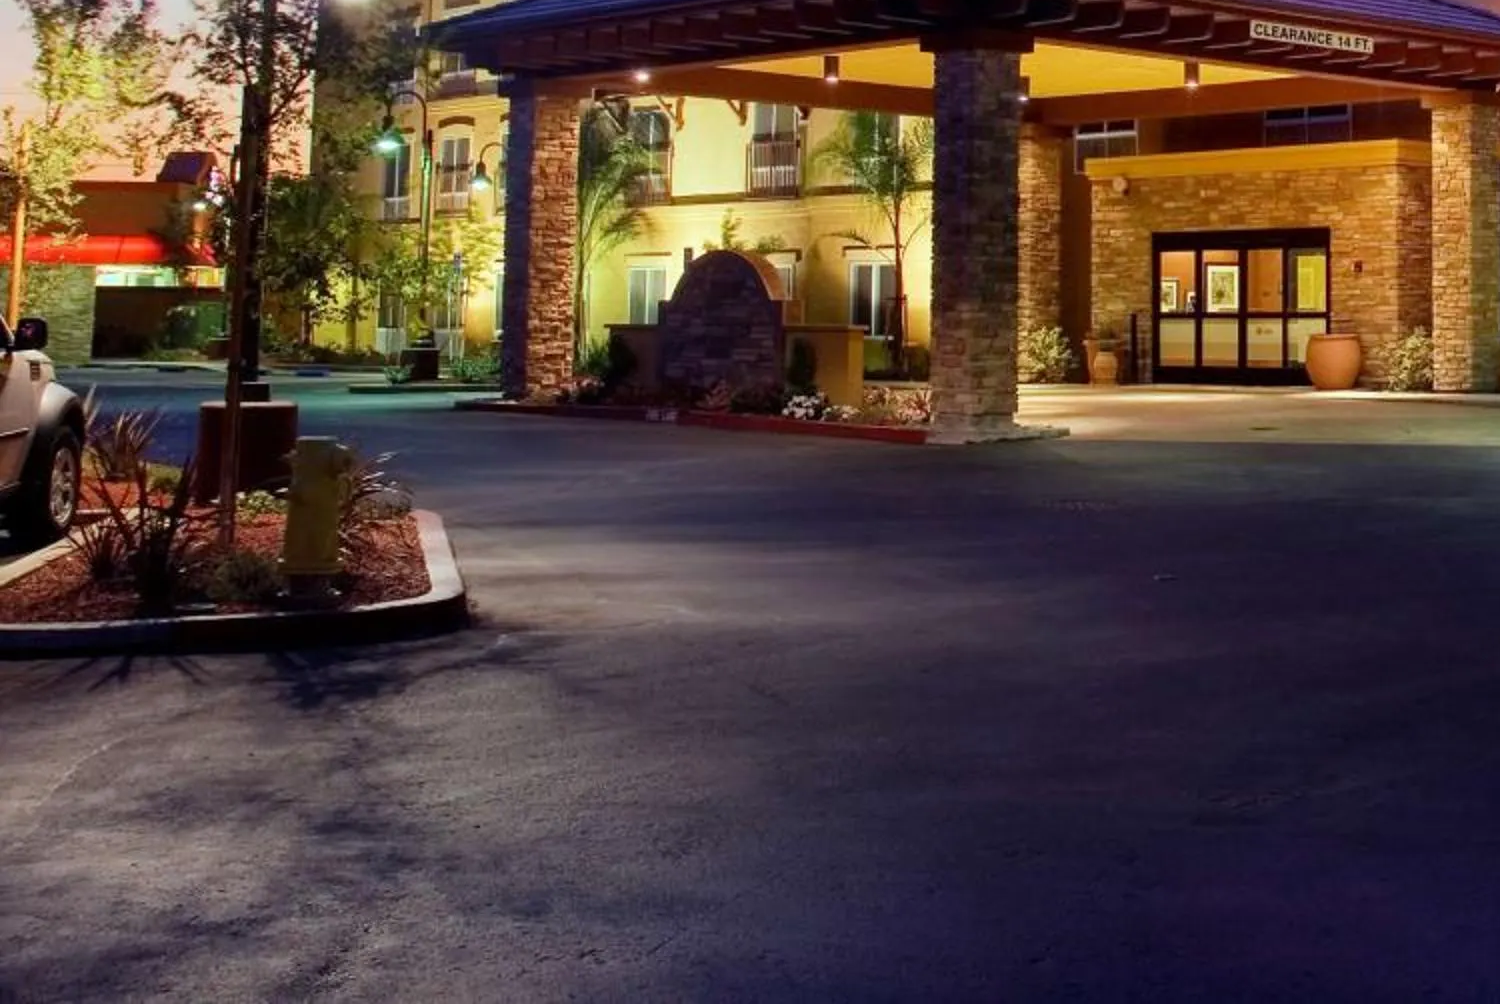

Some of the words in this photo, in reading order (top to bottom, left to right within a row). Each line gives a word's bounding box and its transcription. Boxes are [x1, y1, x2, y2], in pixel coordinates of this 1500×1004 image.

[1253, 22, 1334, 46] CLEARANCE
[1337, 35, 1351, 48] 14
[1354, 36, 1372, 52] FT.
